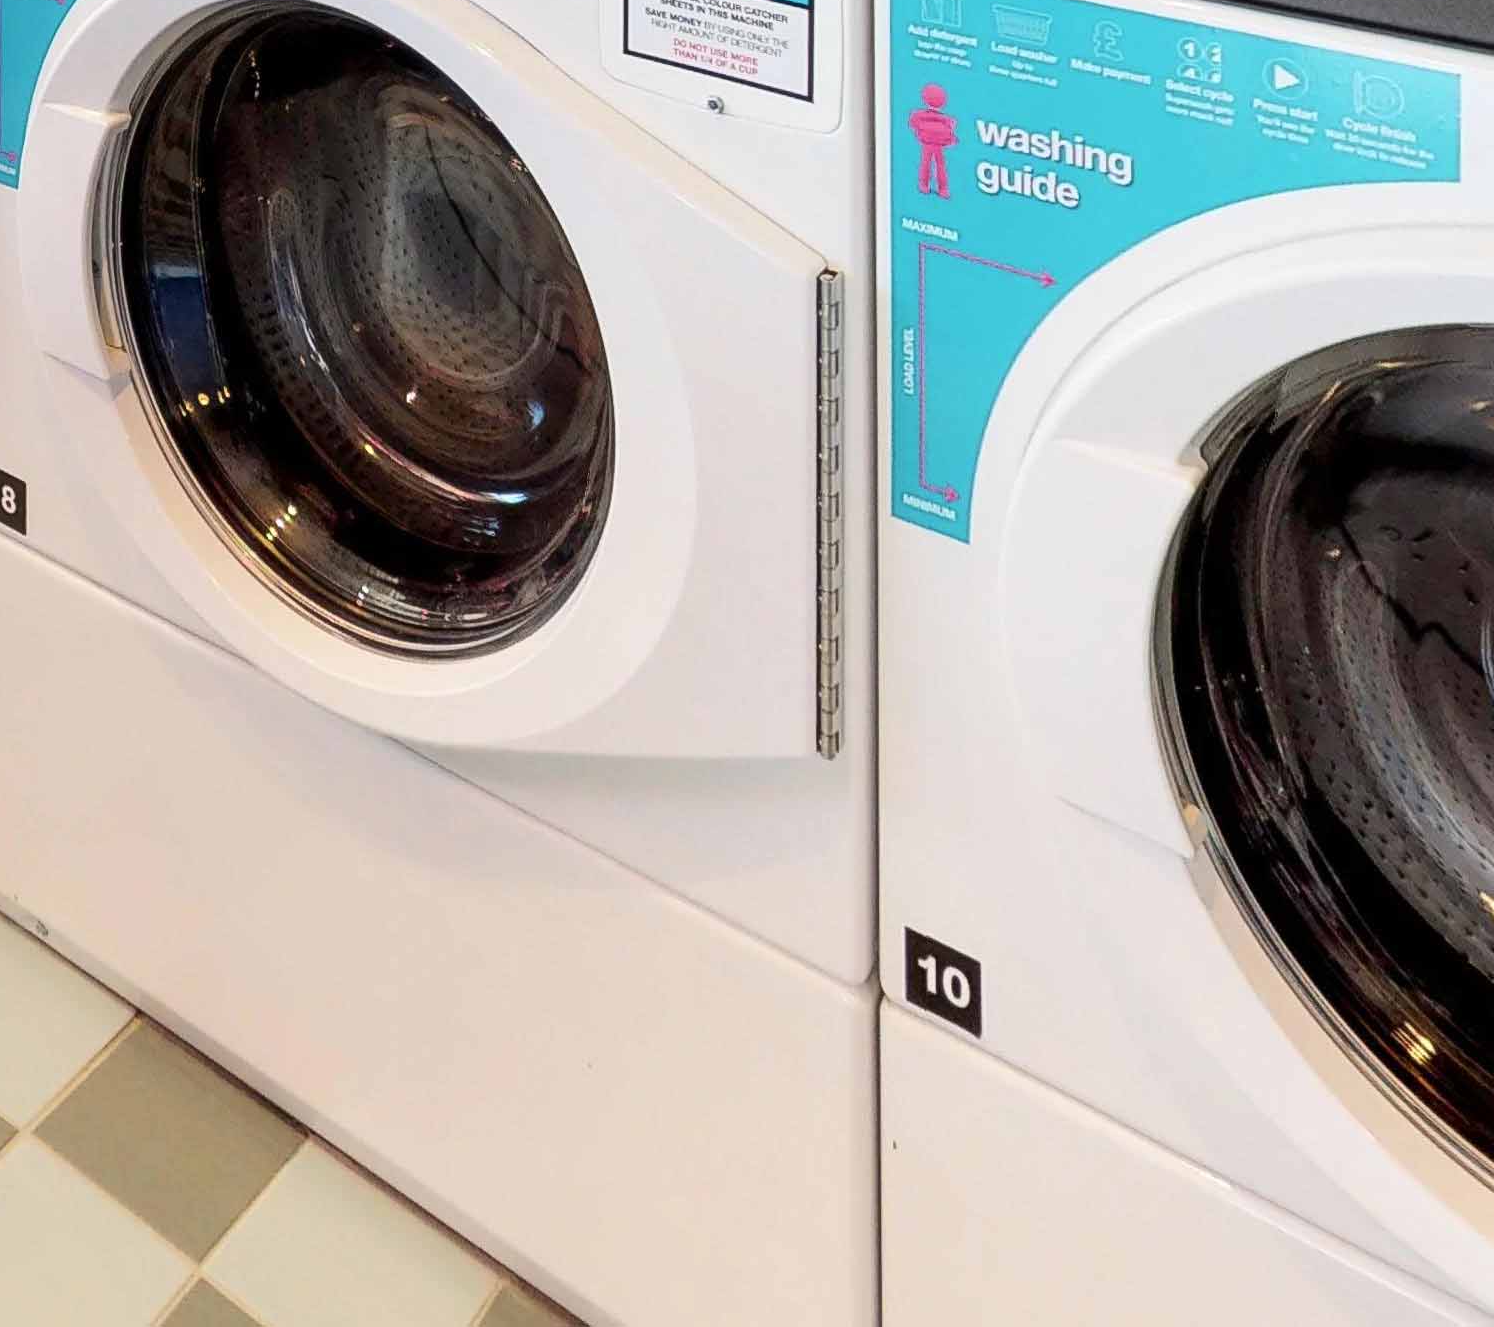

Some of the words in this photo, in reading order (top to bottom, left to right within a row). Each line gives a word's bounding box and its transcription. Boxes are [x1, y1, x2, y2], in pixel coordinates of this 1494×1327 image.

[976, 117, 1135, 187] washing
[975, 160, 1081, 210] guide
[902, 217, 959, 242] MAXIMUM
[902, 327, 914, 363] LEVEL
[903, 362, 915, 396] LOAD
[2, 485, 16, 514] 8
[902, 493, 957, 522] MINIMUM
[917, 955, 971, 1009] 10
